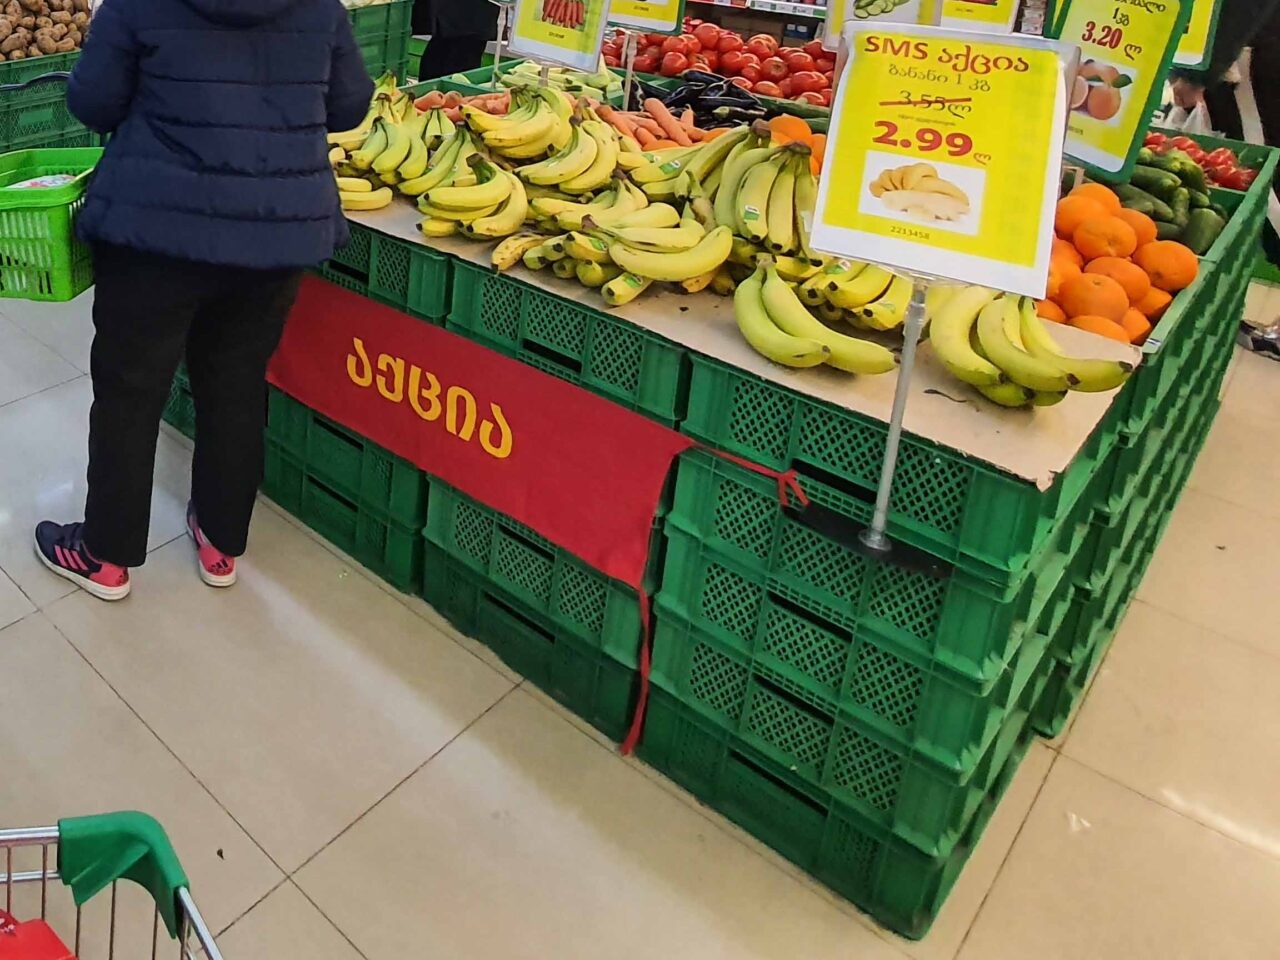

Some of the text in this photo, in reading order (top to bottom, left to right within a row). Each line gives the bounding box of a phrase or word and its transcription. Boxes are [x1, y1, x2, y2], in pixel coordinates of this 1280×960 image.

[864, 36, 1030, 75] SMS აქცია
[1081, 20, 1142, 60] 3.20 ლ
[888, 63, 949, 83] ბანანი
[872, 120, 973, 157] 2.99
[973, 152, 992, 166] ლ
[346, 336, 513, 459] აქცია
